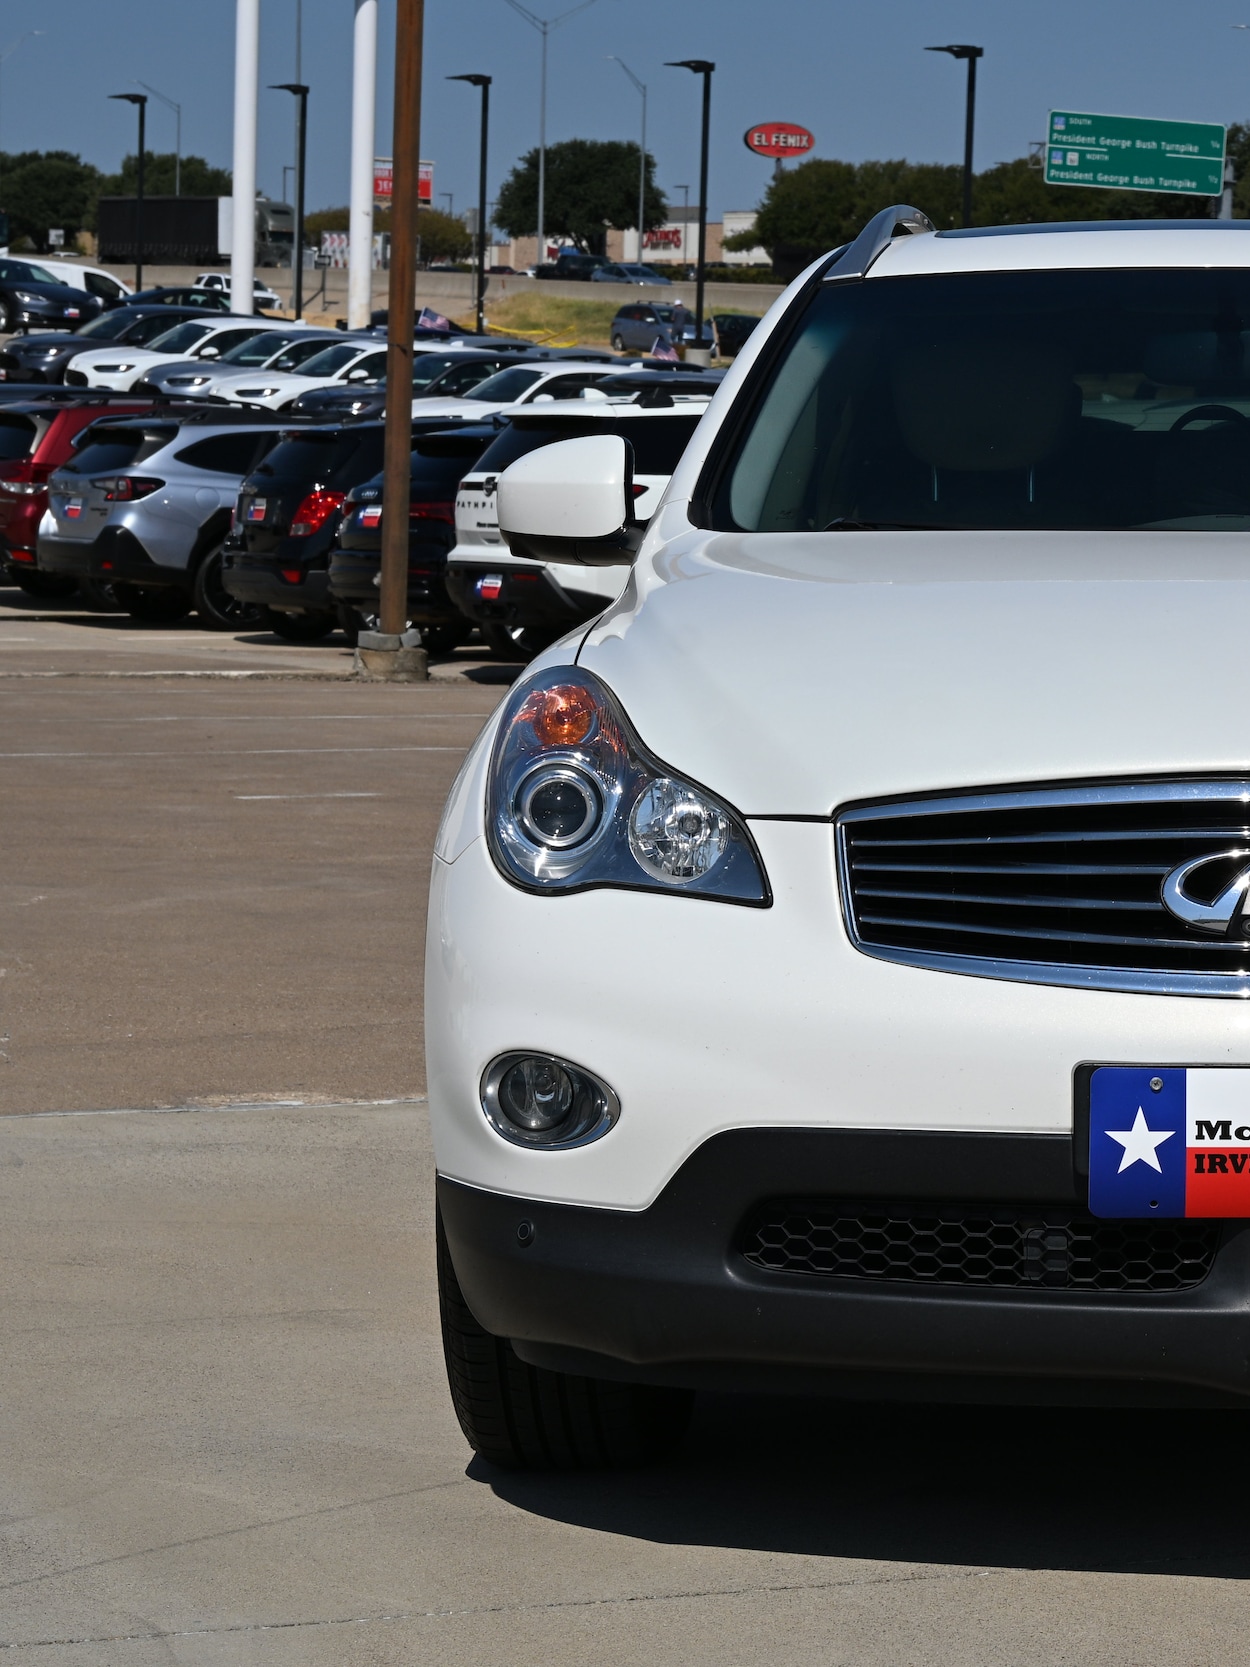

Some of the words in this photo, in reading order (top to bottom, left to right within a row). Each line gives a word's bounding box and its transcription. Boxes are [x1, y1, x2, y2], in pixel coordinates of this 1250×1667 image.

[1069, 117, 1092, 125] SOUTH
[754, 133, 768, 146] EL
[772, 133, 809, 148] FENIX
[1052, 133, 1096, 144] President
[1099, 137, 1132, 149] George
[1135, 139, 1157, 149] Bush
[1161, 142, 1199, 153] Turnpike
[1085, 153, 1109, 161] NORTH
[1050, 169, 1093, 181] President
[1097, 173, 1129, 184] George
[1133, 175, 1155, 185] Bush
[1159, 177, 1197, 189] Turnpike
[457, 501, 493, 509] PATHFI
